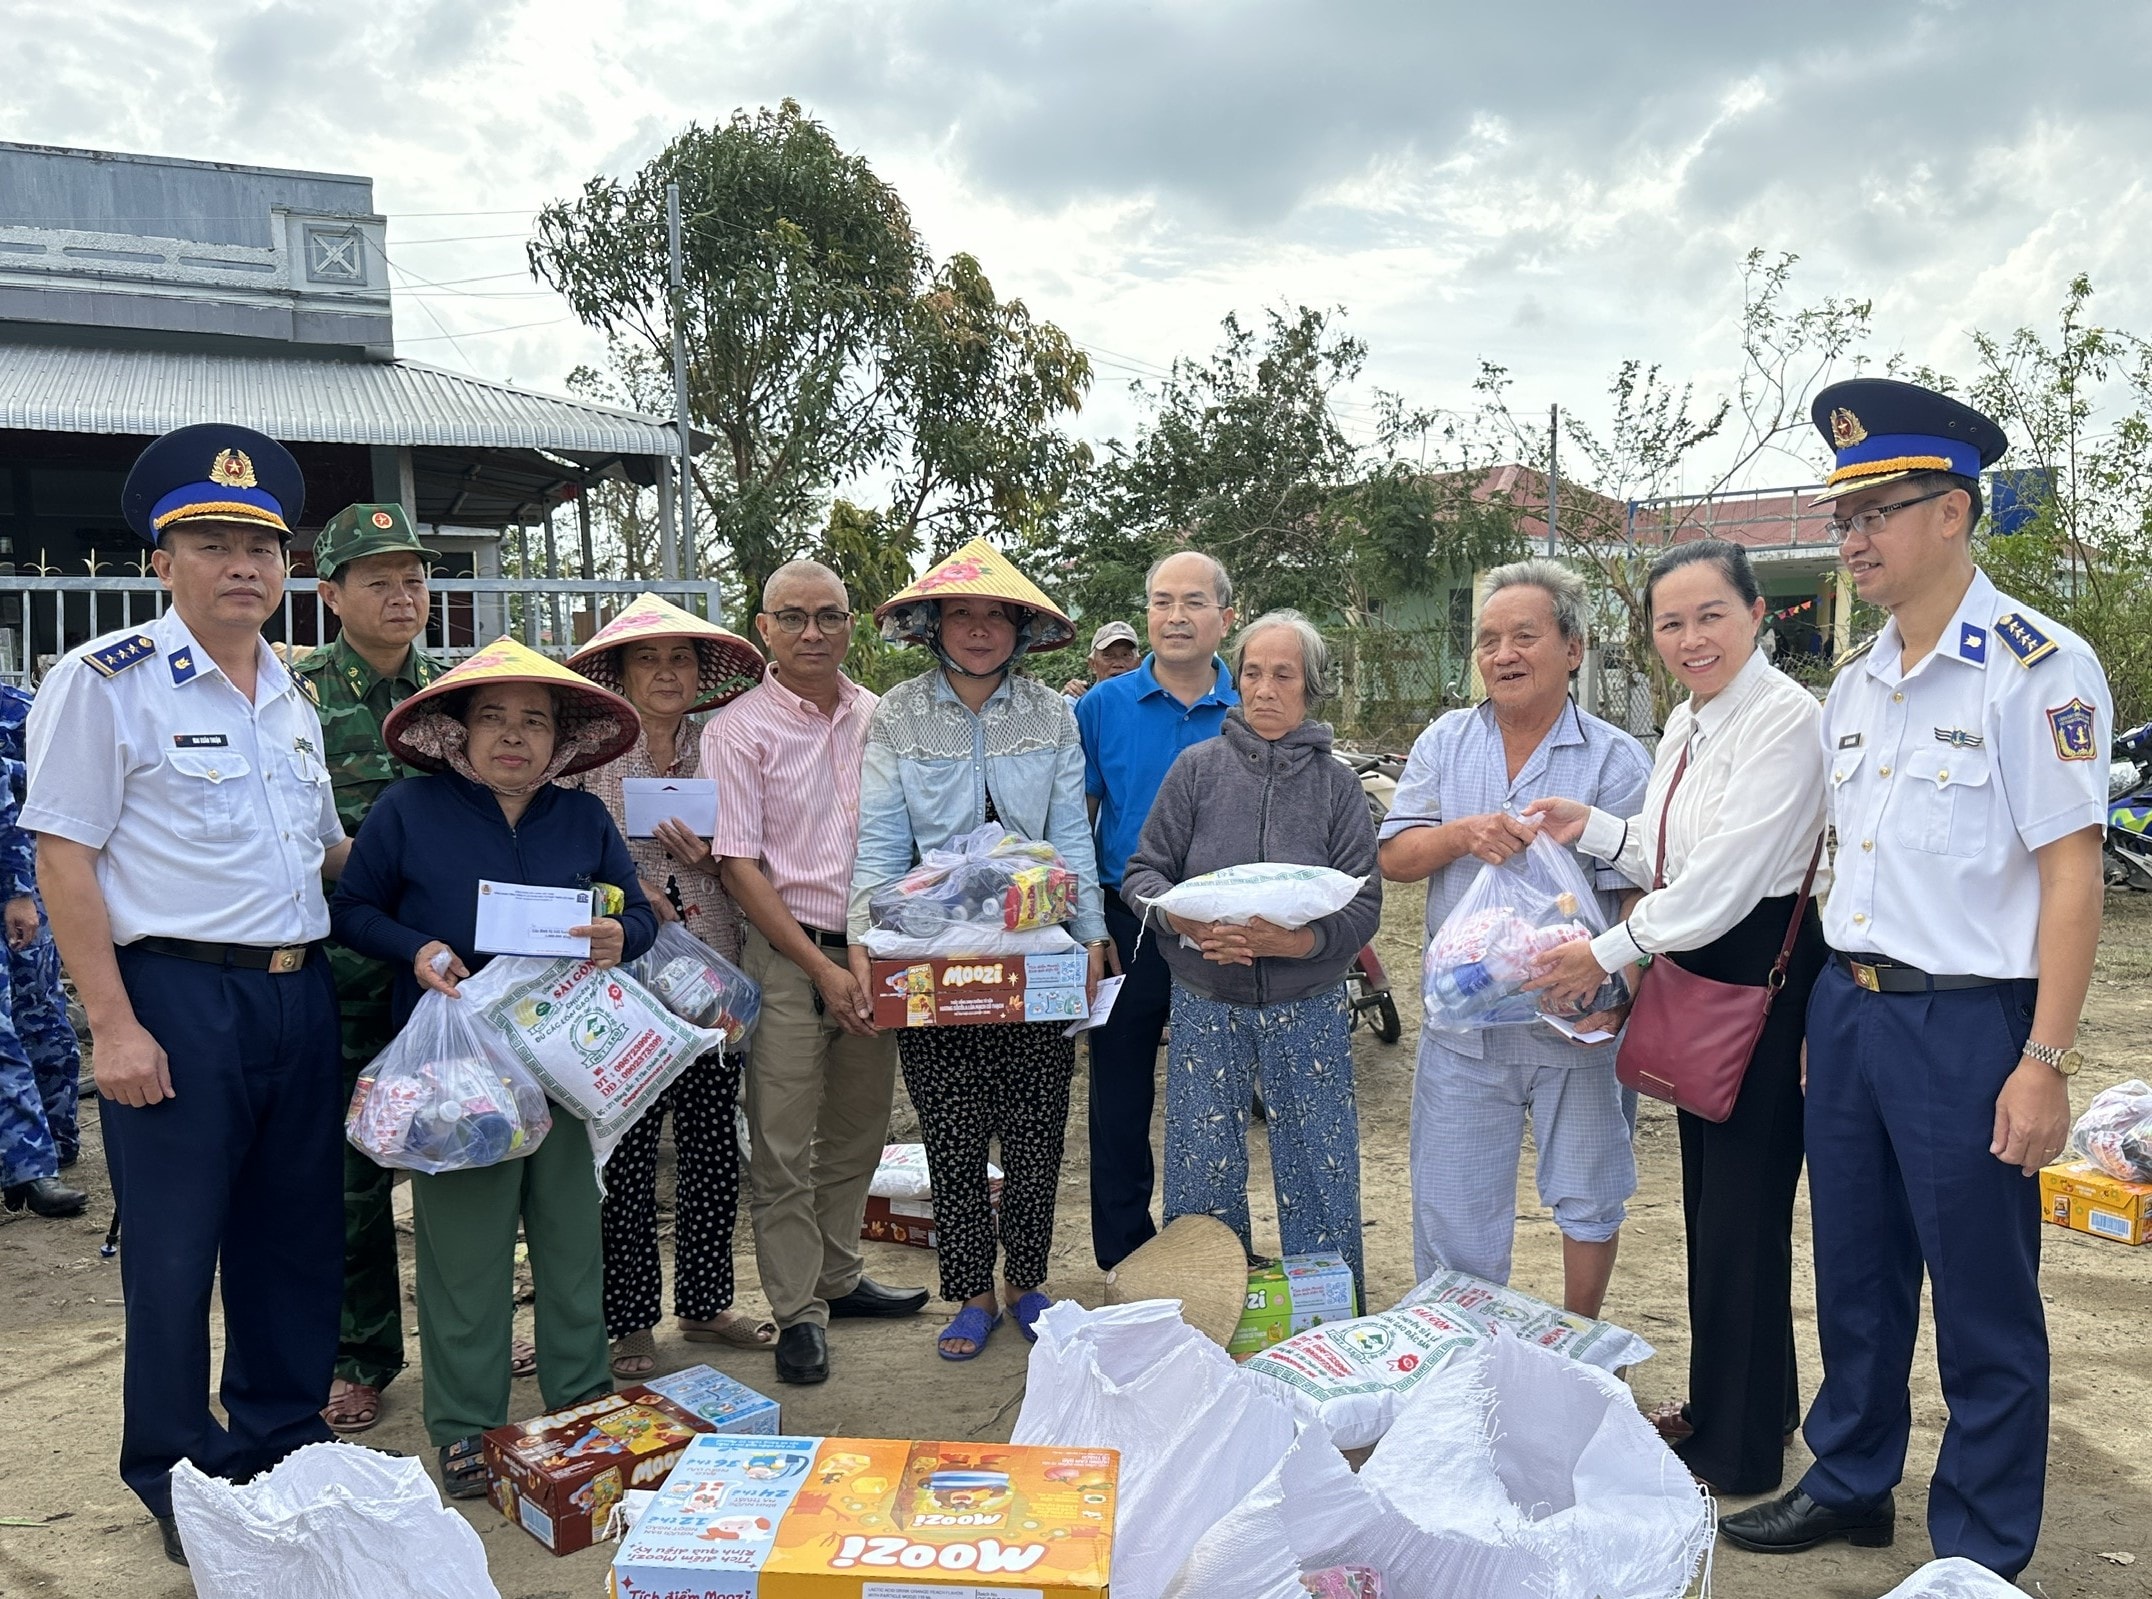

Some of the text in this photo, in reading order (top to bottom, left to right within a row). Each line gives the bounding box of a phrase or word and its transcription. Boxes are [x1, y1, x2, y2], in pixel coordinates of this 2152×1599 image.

[554, 960, 596, 998] SÀI GÒN
[534, 1032, 546, 1043] ĐỦ
[546, 1022, 560, 1035] CÁC
[560, 1010, 576, 1026] LOẠI
[576, 996, 590, 1012] GẠO
[594, 1076, 609, 1090] ĐT
[600, 1082, 617, 1097] DĐ
[1404, 1328, 1421, 1344] ĐẶC
[712, 1459, 741, 1468] 36
[758, 1488, 790, 1498] 24
[678, 1516, 710, 1526] 12
[655, 1546, 689, 1556] diệu
[692, 1547, 720, 1556] quà
[722, 1548, 756, 1556] Rinh
[680, 1554, 718, 1564] điểm
[721, 1555, 752, 1564] Tích
[704, 1590, 752, 1599] Moozi
